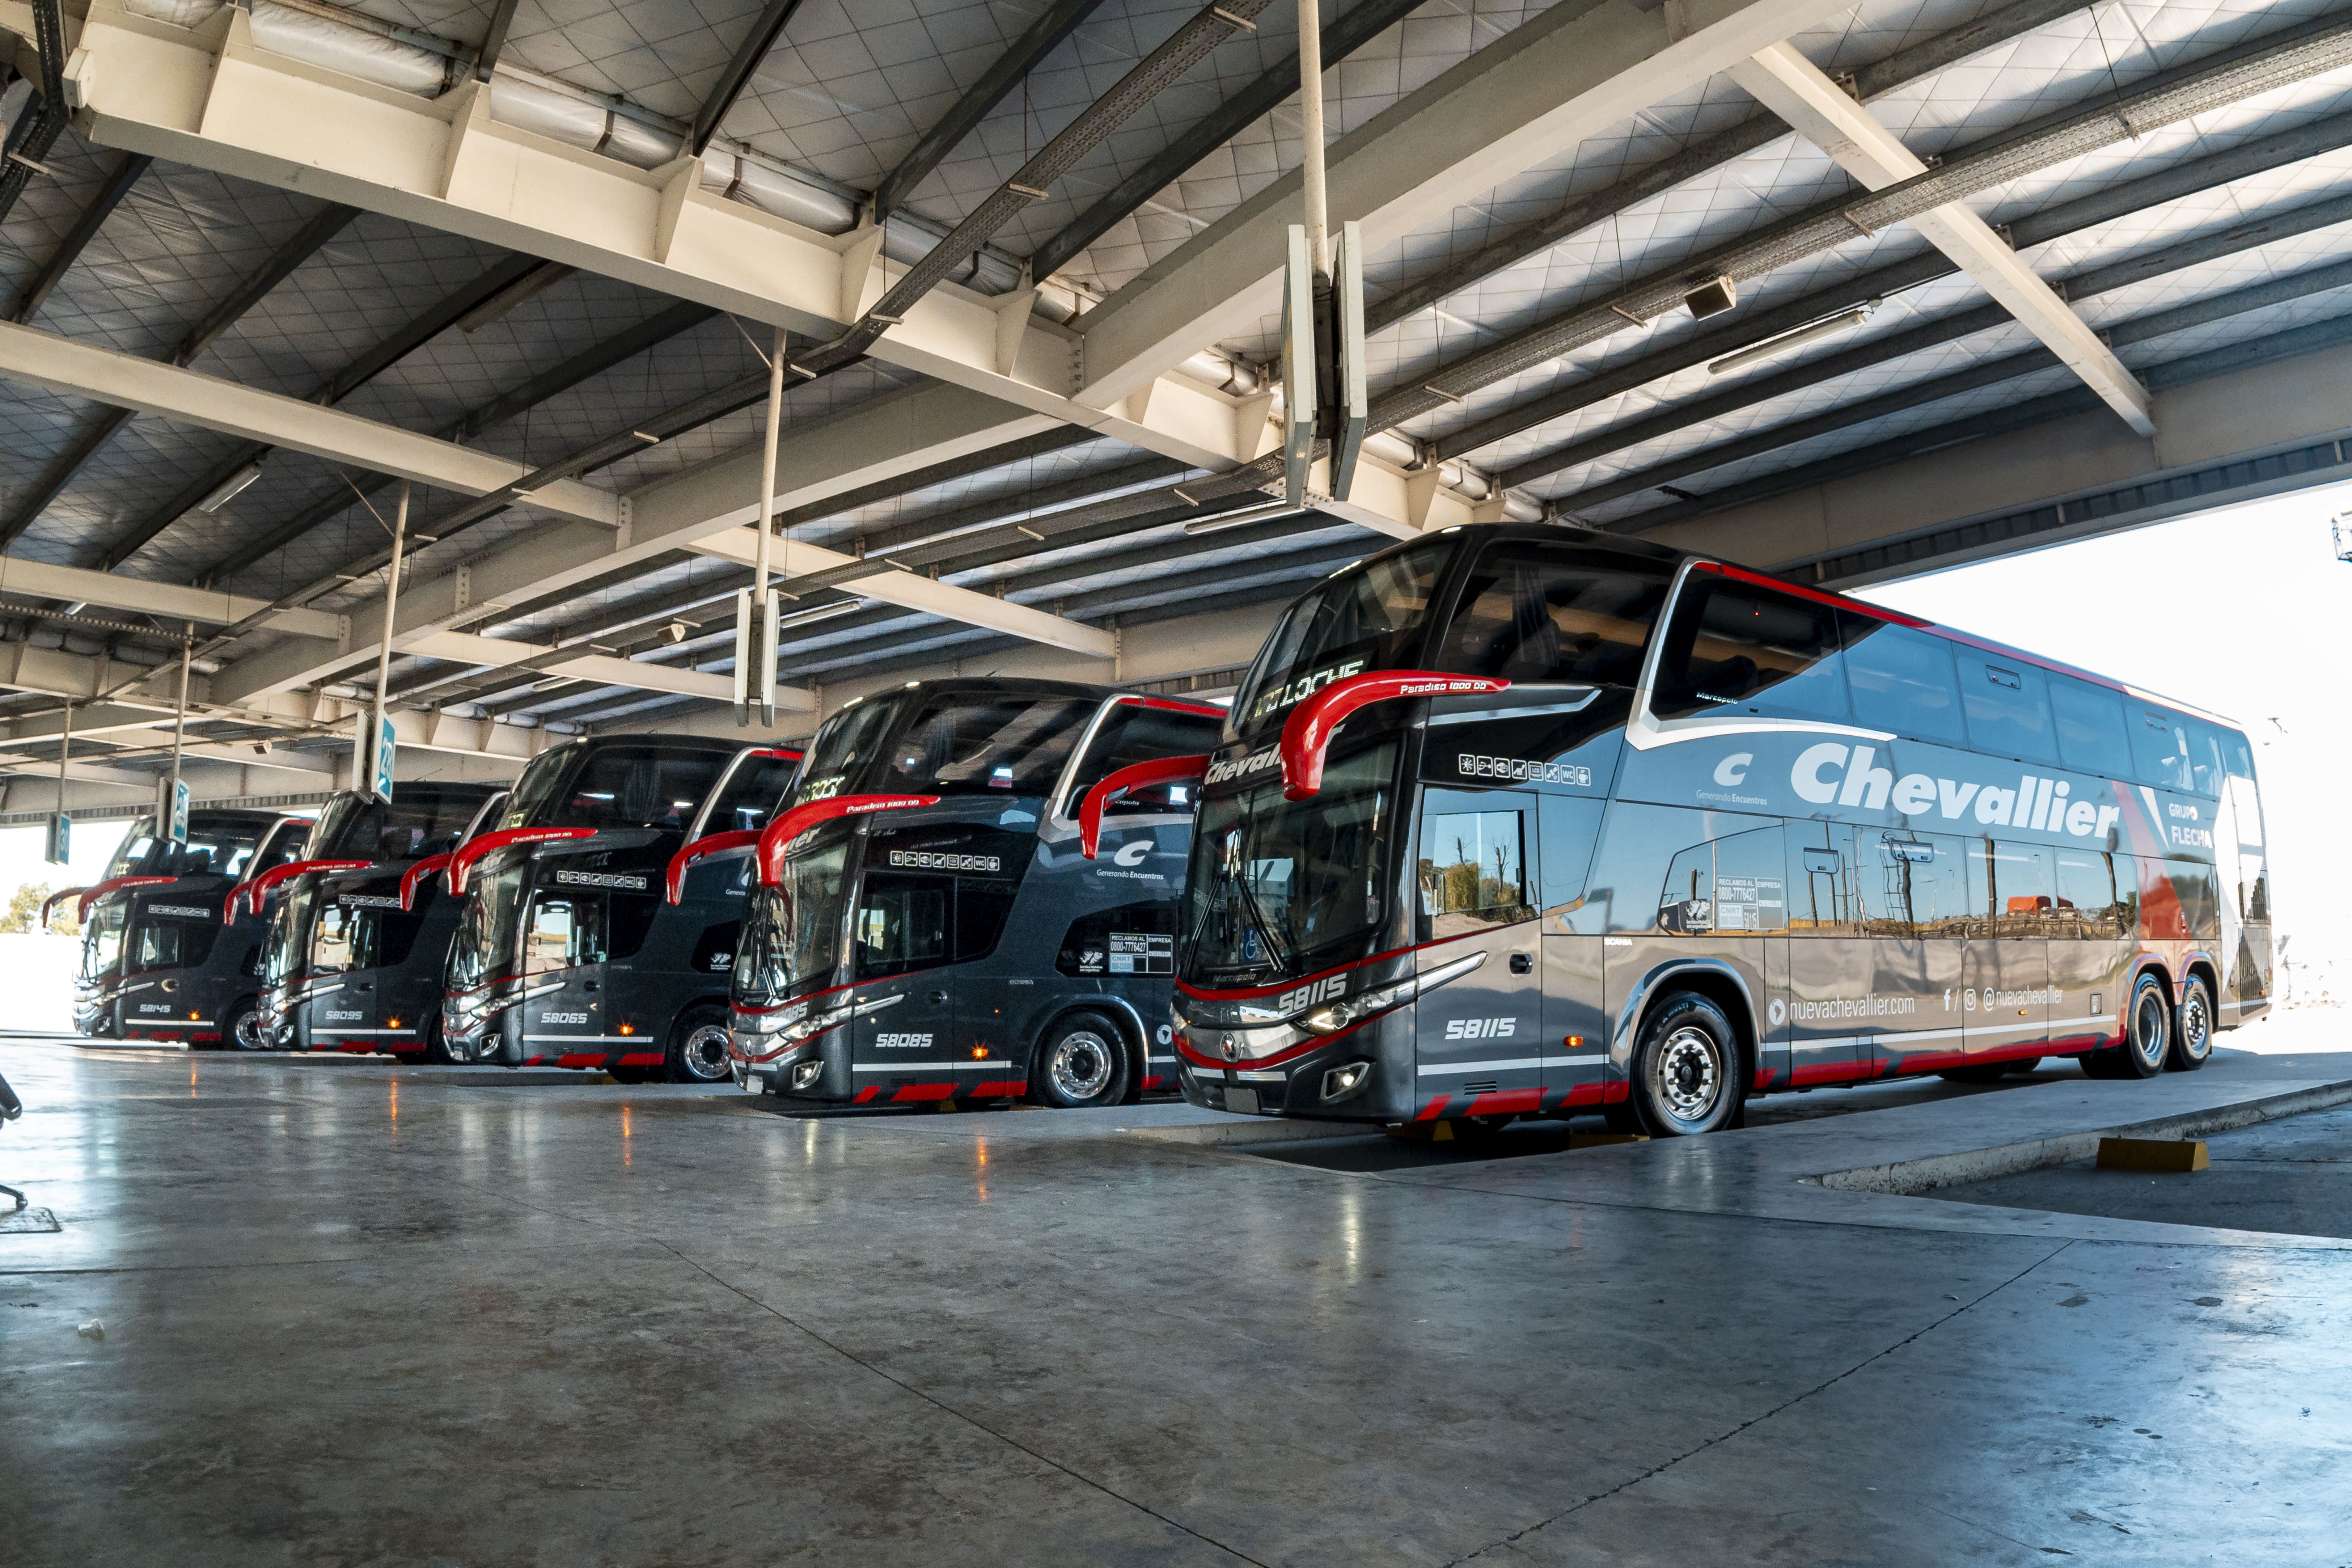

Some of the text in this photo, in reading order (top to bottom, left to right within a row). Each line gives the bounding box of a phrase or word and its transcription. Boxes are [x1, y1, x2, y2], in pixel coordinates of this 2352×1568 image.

[1400, 682, 1447, 694] Paradiso
[1696, 692, 1738, 704] Marcopolo
[1562, 770, 1574, 779] WC
[1790, 742, 2120, 840] Chevallier
[1696, 789, 1768, 806] Generando Encuentros
[846, 802, 885, 813] Paradiso
[2169, 803, 2198, 821] GRUPO
[2171, 825, 2213, 848] FLECHA
[1096, 869, 1164, 880] Generando Encuentros
[1111, 942, 1146, 952] 0800-7776427
[1604, 937, 1633, 946] SCANIA
[1279, 973, 1347, 1014] 58115
[139, 1004, 171, 1013] 58145
[1790, 993, 1915, 1020] nuevachevallier.com
[325, 1010, 363, 1020] 58095
[541, 1013, 588, 1024] 58065
[1445, 1017, 1516, 1040] 58115
[876, 1034, 933, 1047] 58085
